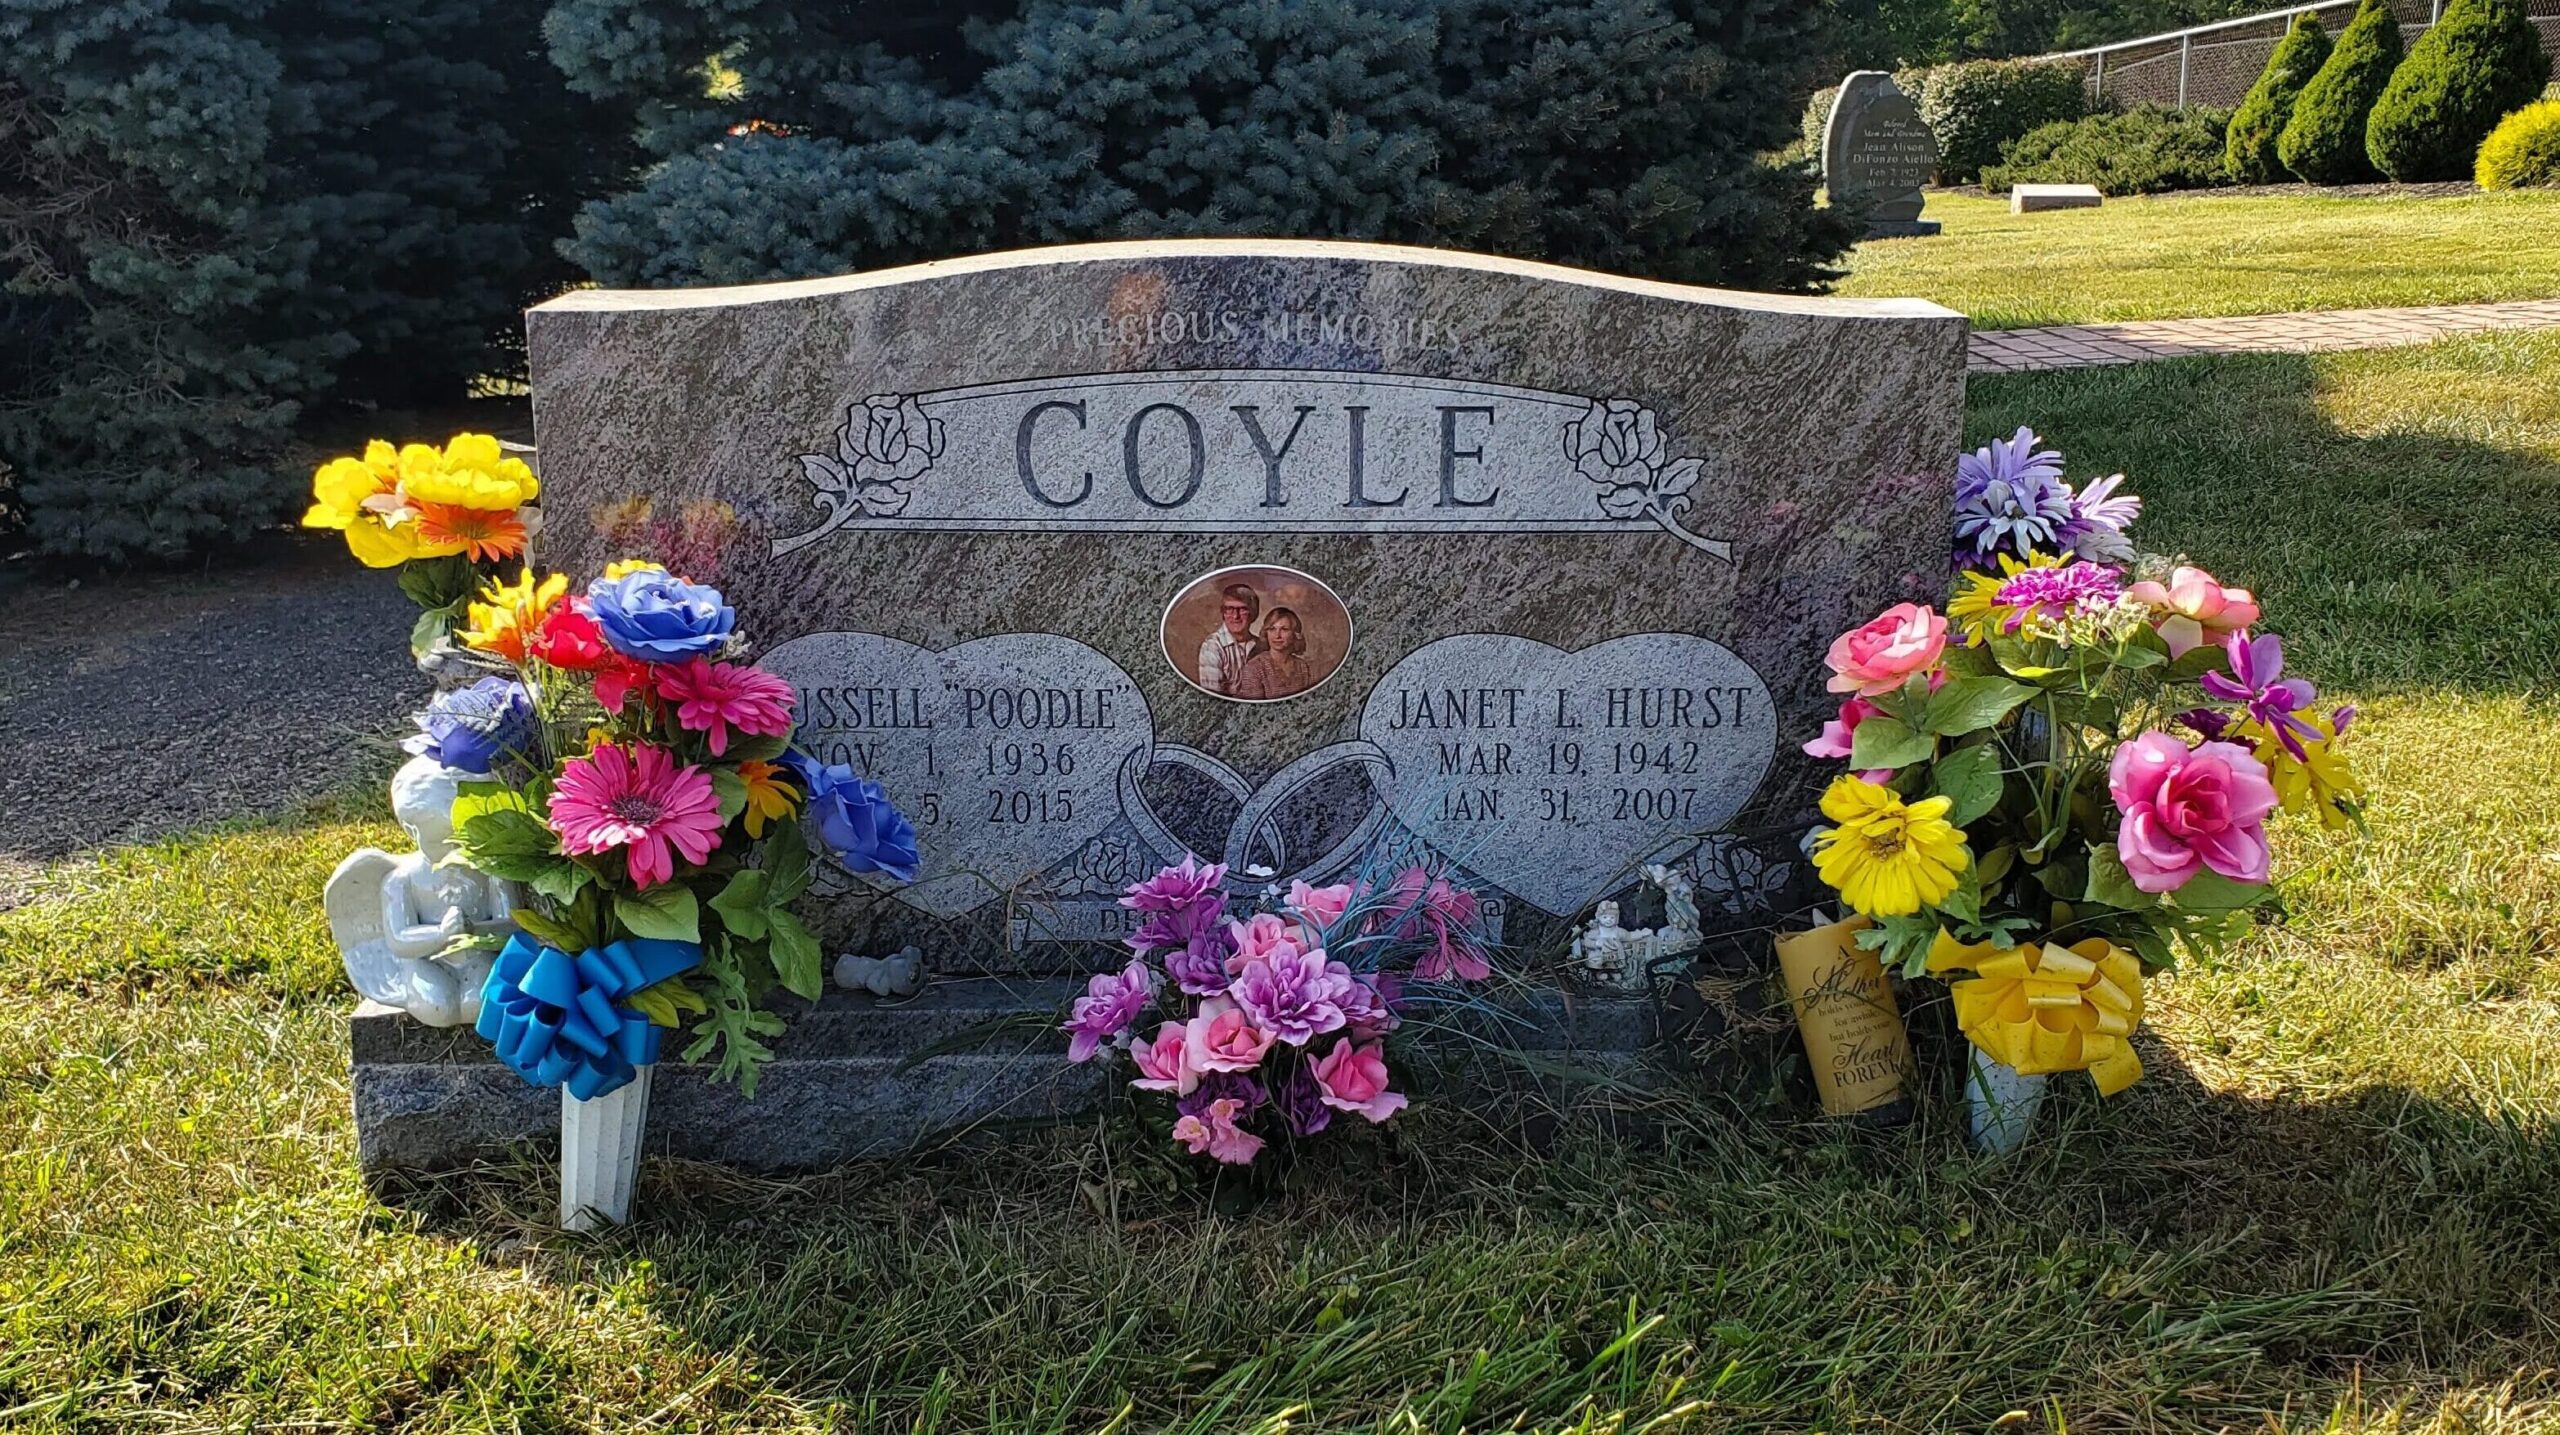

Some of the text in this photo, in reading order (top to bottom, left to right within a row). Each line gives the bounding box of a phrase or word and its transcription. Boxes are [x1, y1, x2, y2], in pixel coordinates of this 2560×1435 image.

[1853, 153, 1935, 164] DiFonzo Aiello
[1864, 142, 1925, 152] Jean Alison
[1048, 311, 1462, 352] PRECIOUS MEMORIES
[1015, 399, 1501, 510] COYLE
[1389, 685, 1753, 730] JANET L. HURST
[985, 742, 1075, 776] 1936
[1438, 741, 1698, 778] MAR. 19, 1942
[987, 789, 1073, 825] 2015
[1436, 787, 1699, 824] JAN. 31, 2007
[1832, 1034, 1897, 1071] Heart
